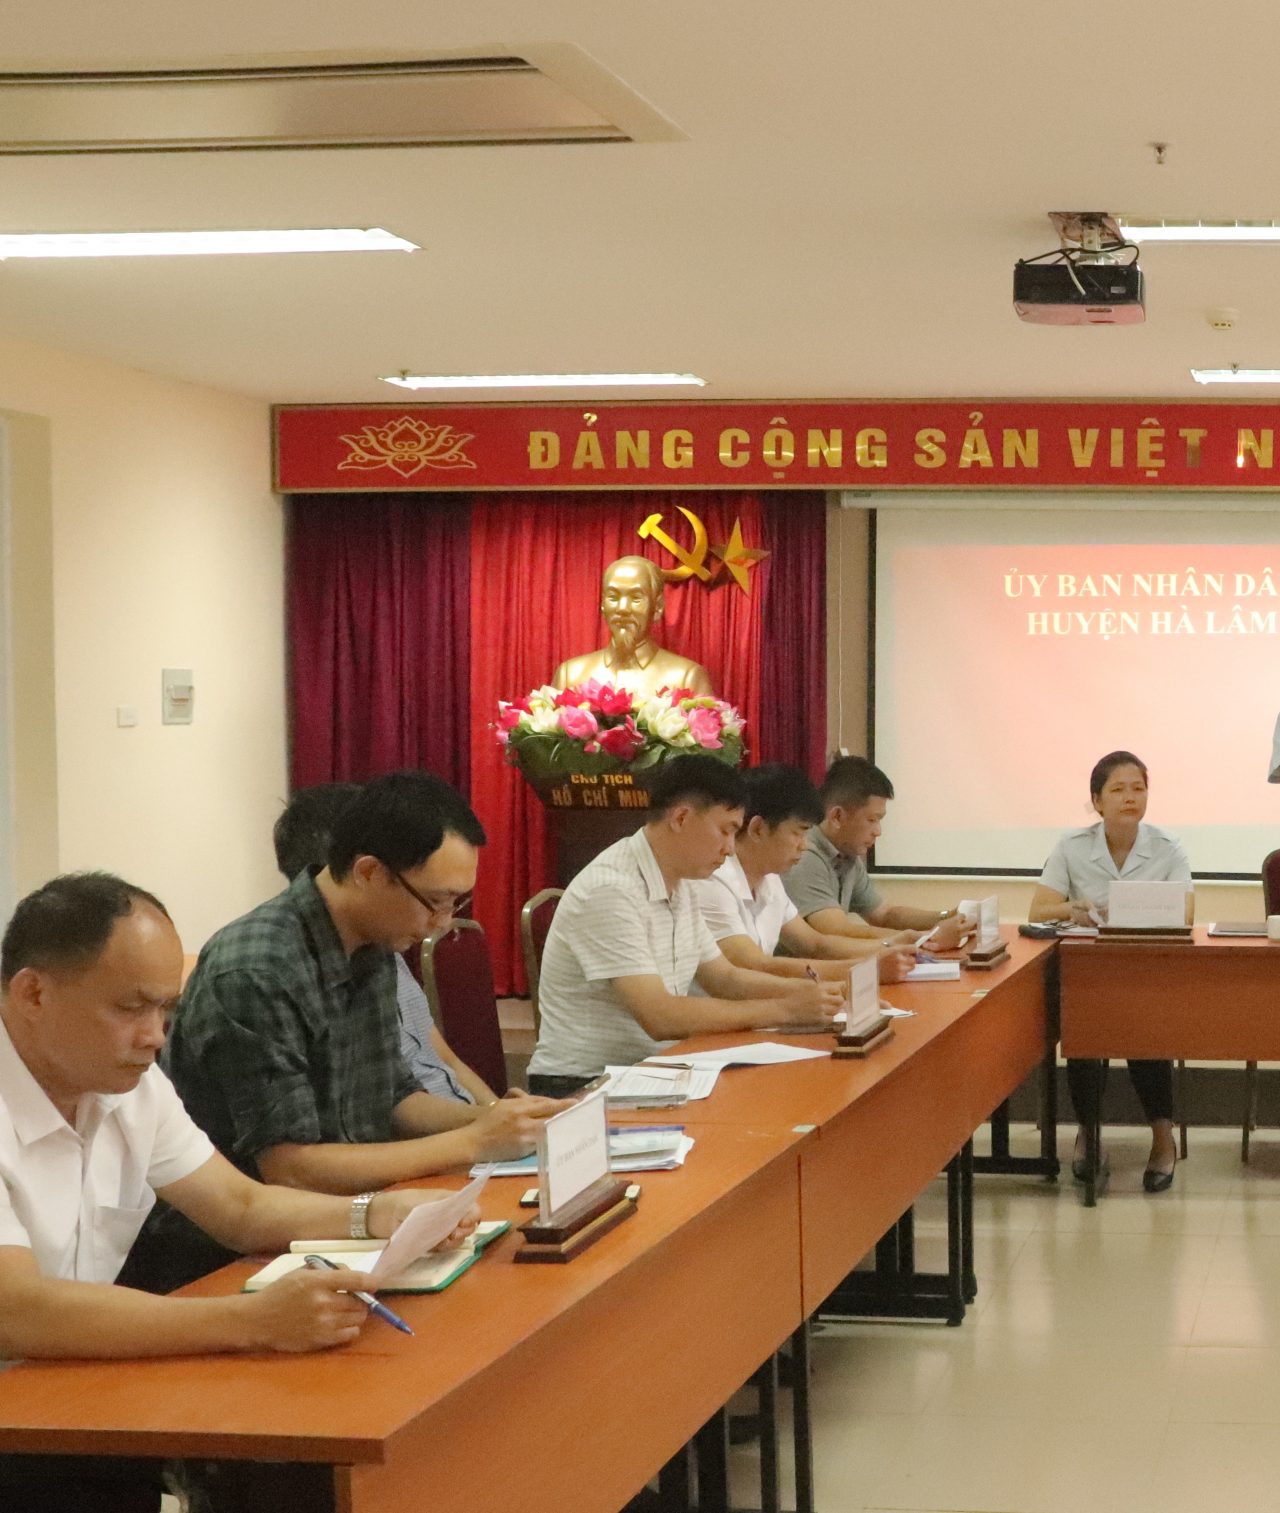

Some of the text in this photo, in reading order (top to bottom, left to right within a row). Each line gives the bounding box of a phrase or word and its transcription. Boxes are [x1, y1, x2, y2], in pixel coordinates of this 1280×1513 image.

[527, 412, 694, 469] ĐẢNG
[718, 416, 888, 479] CỘNG
[914, 411, 1039, 469] SẢN
[1067, 417, 1208, 478] VIỆT
[1003, 568, 1048, 598] ỦY
[1057, 573, 1123, 597] BAN
[1133, 567, 1224, 597] NHÂN
[1026, 604, 1278, 641] HUYỆN HÀ LÂM
[618, 790, 650, 807] MIN
